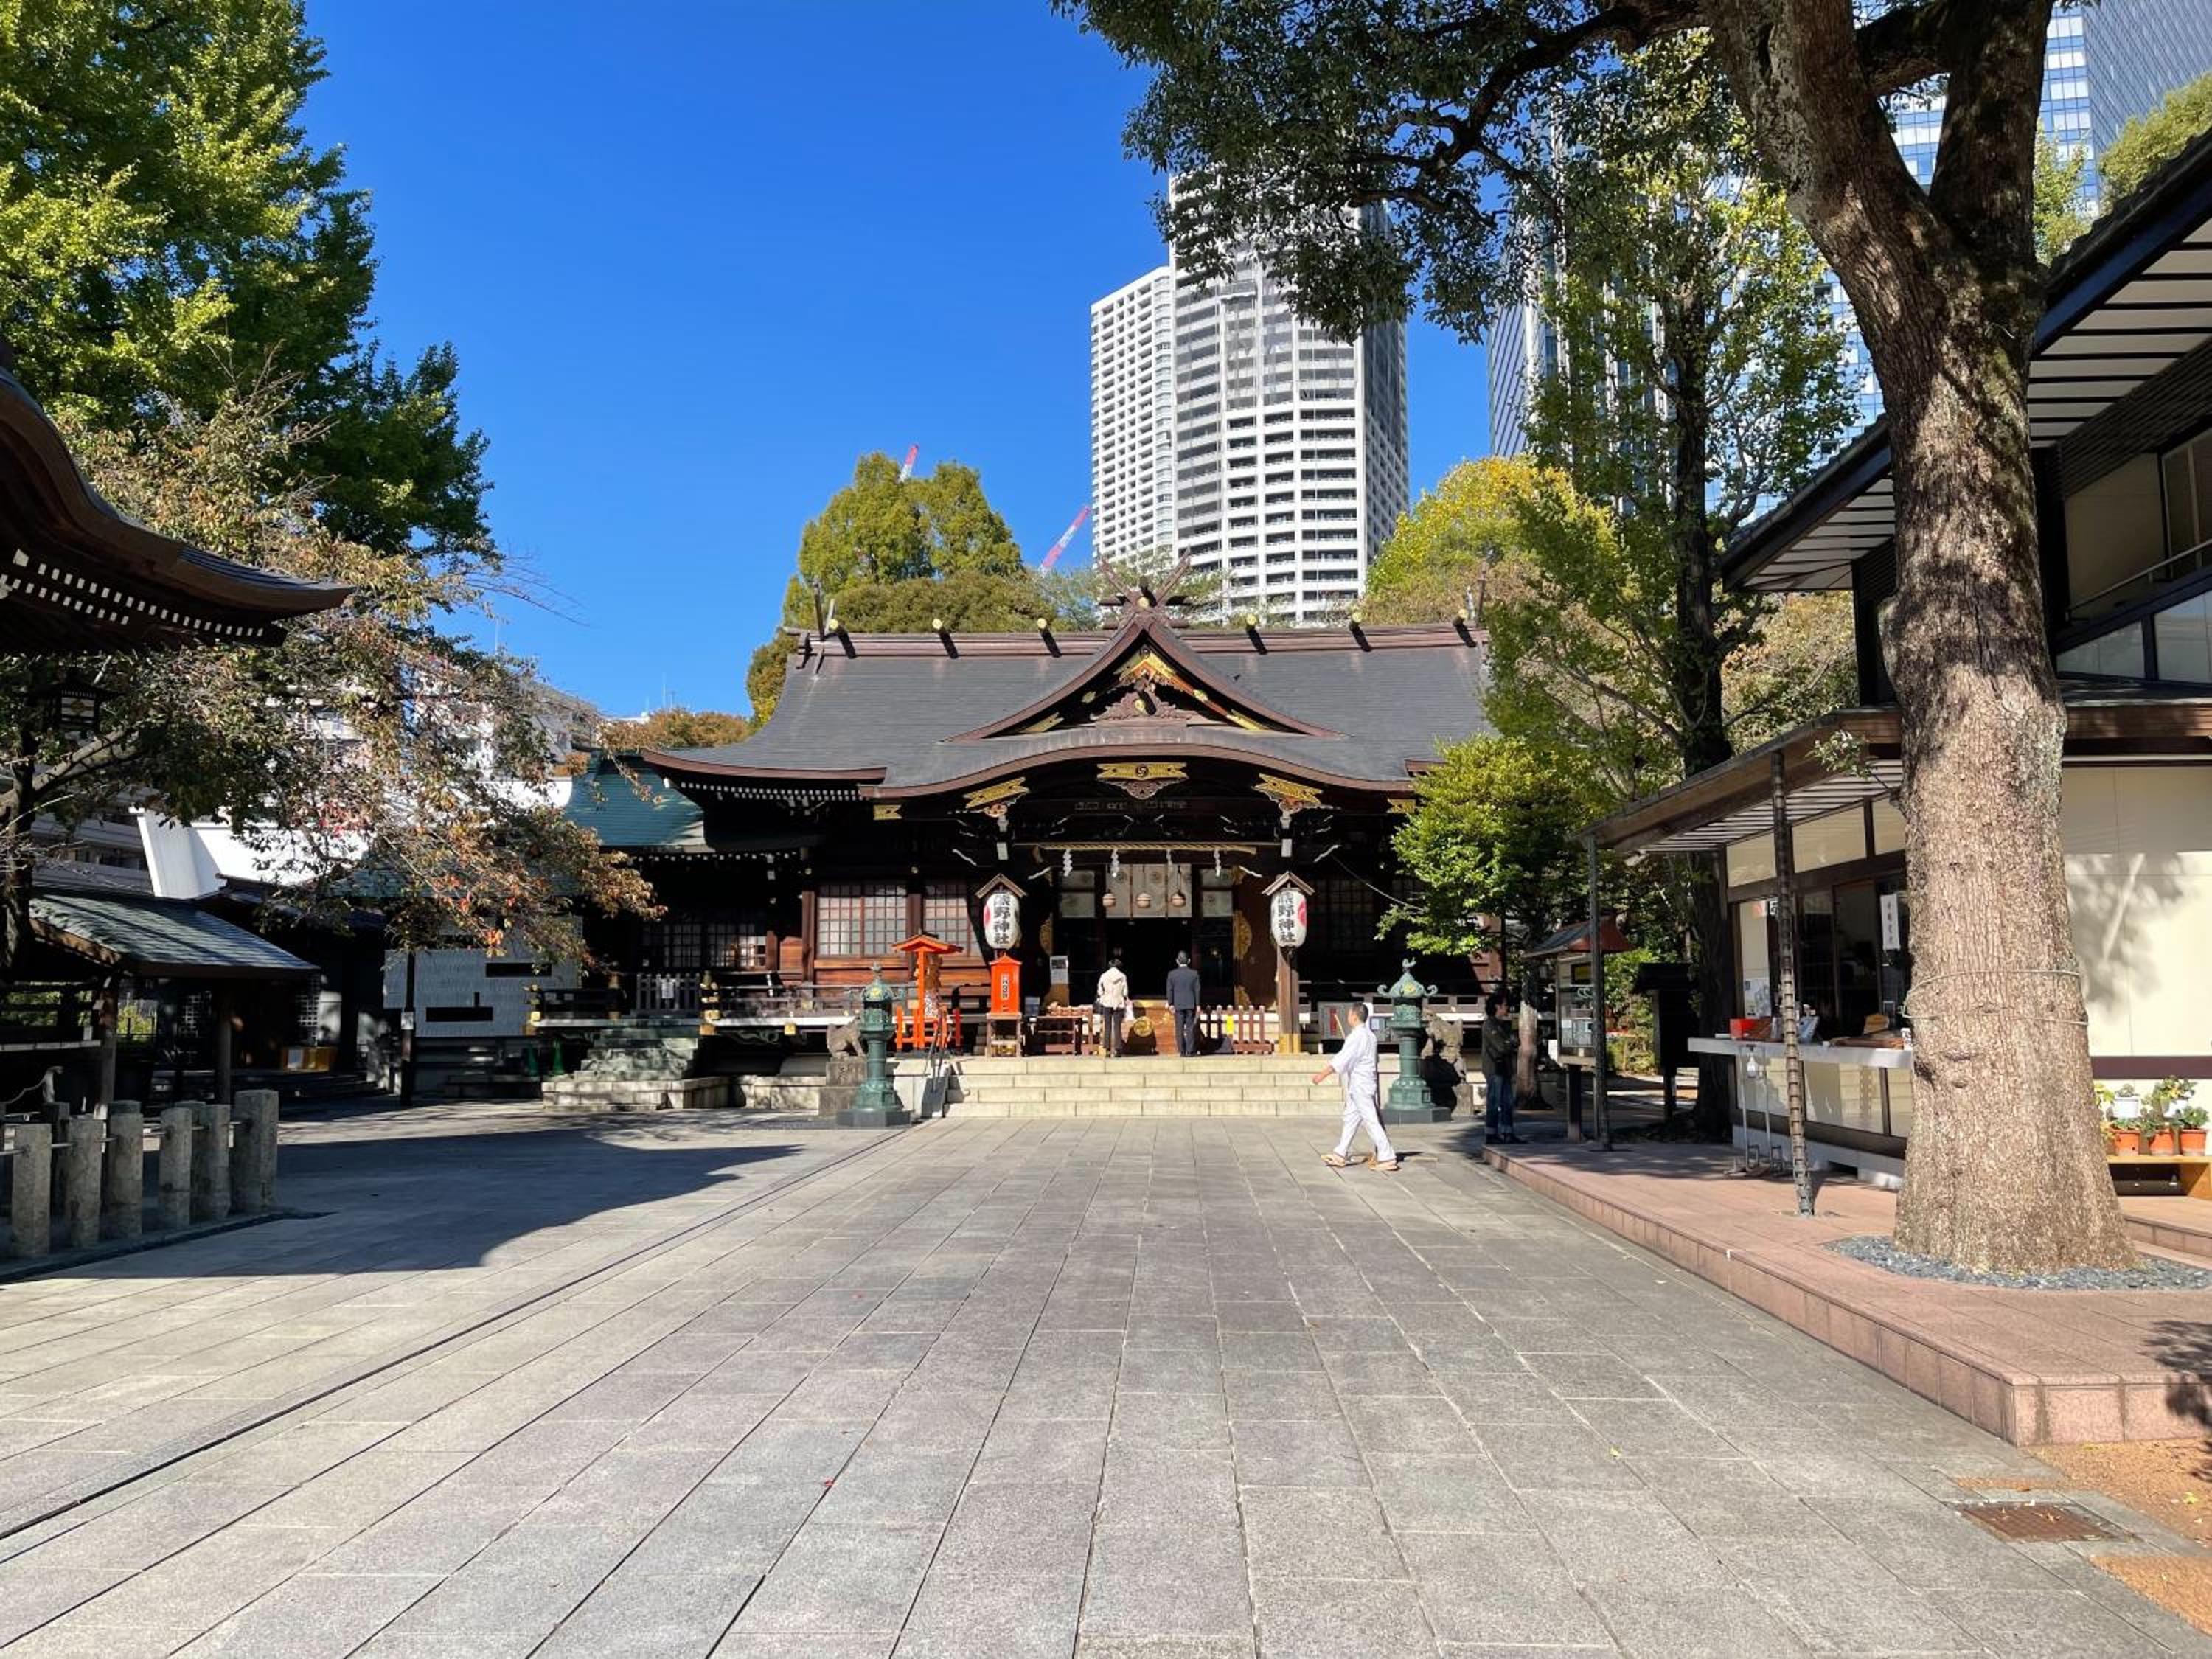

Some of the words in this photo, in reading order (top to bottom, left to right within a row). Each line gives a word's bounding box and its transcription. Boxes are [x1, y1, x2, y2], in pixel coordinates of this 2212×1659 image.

[993, 894, 1011, 945] 熊野神社
[1278, 891, 1295, 943] 熊野神社
